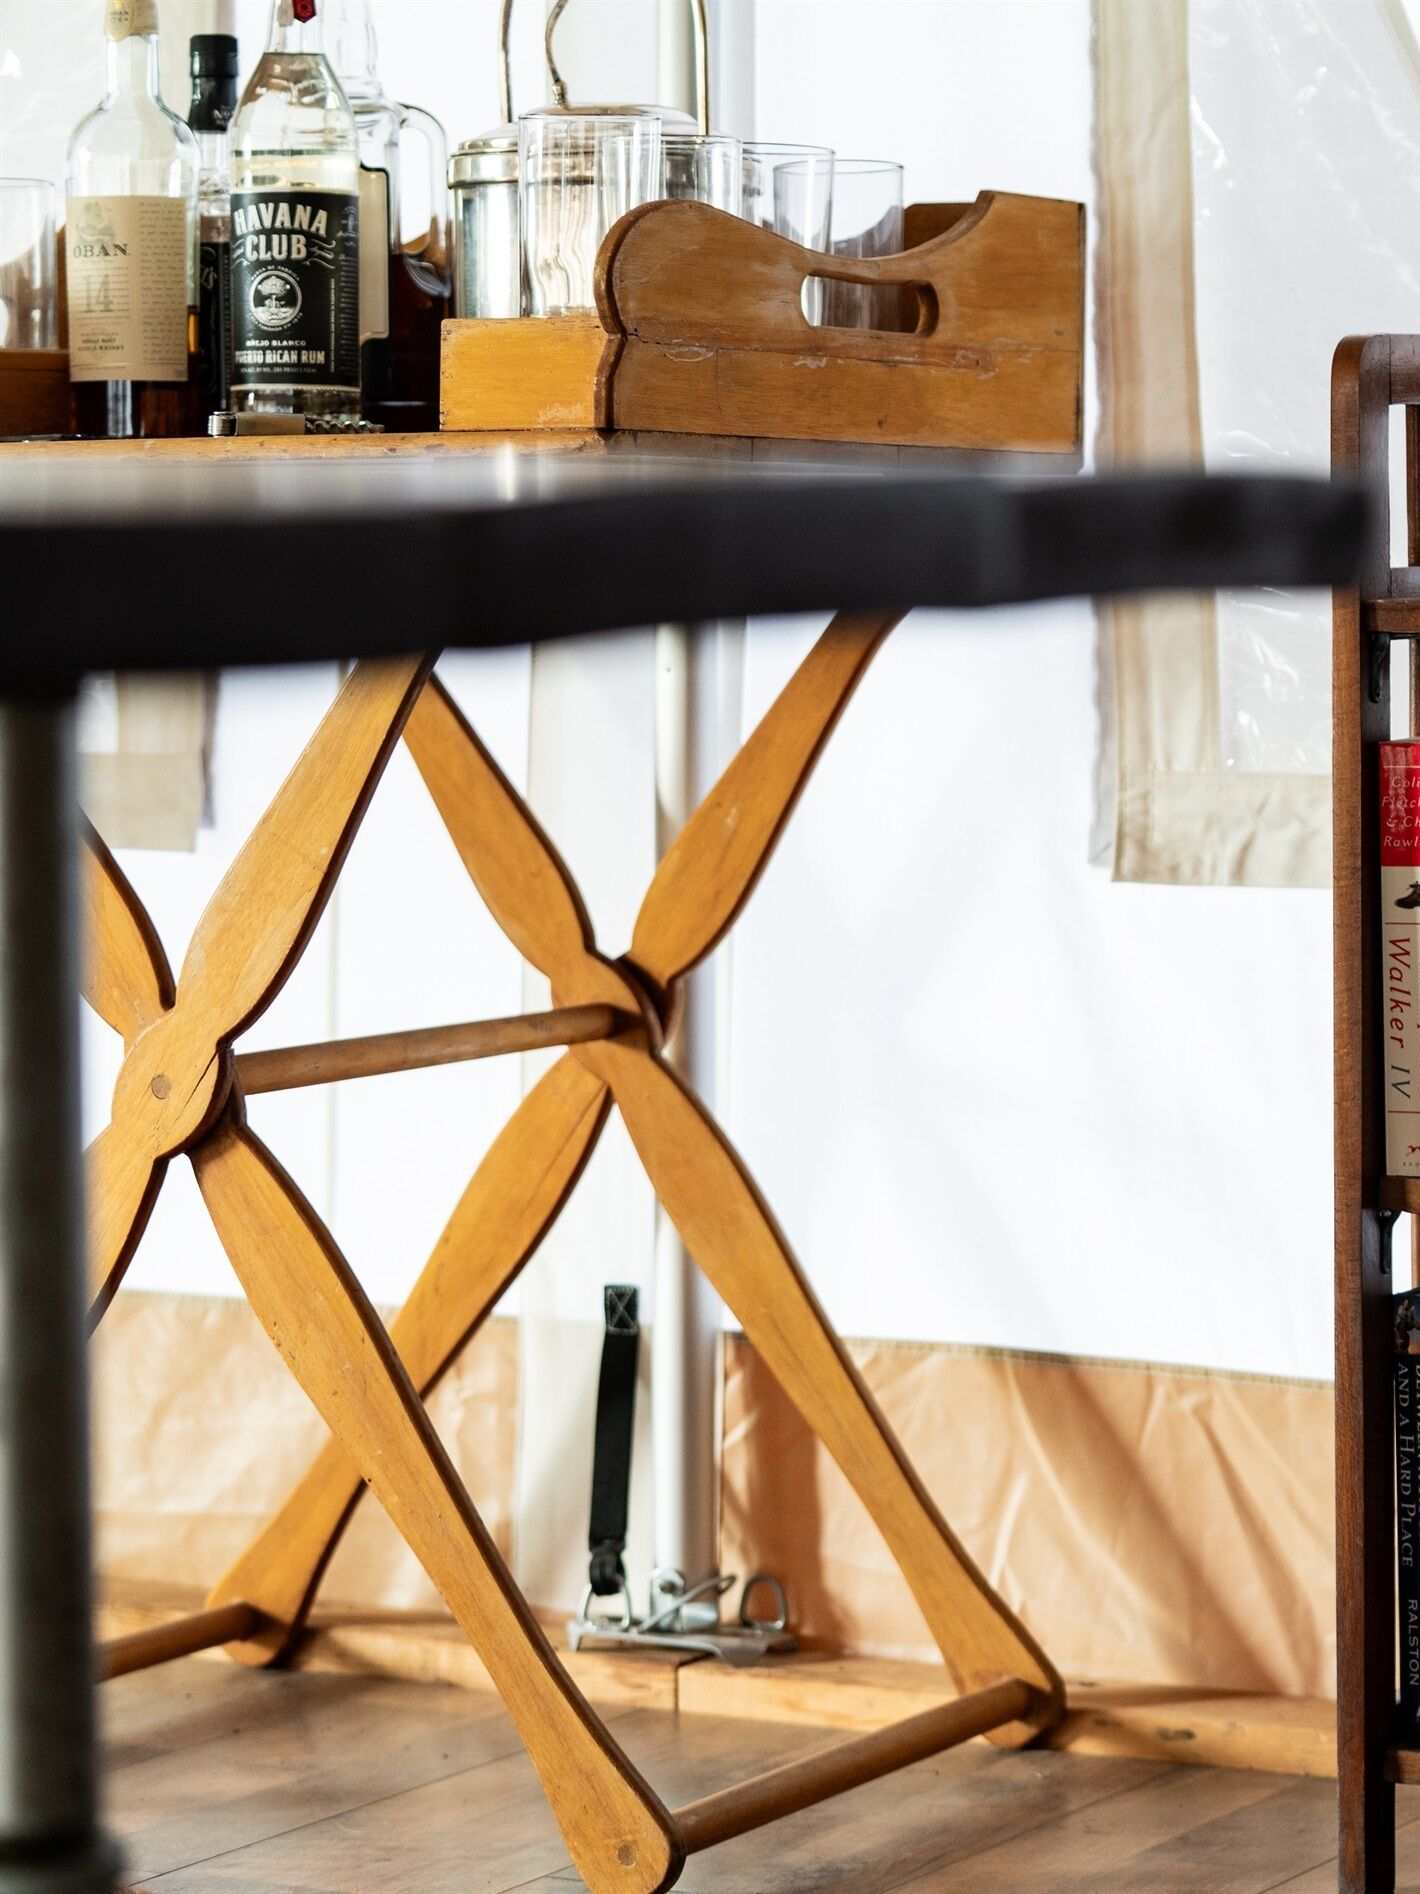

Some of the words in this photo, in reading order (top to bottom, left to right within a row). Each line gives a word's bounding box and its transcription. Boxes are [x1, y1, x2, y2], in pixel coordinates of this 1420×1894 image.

[233, 202, 328, 237] HAVANA
[245, 233, 308, 262] CLUB
[265, 350, 298, 364] RICAN
[303, 350, 326, 364] RUM
[1388, 936, 1411, 1049] Walker
[1391, 1064, 1411, 1099] IV
[1408, 1599, 1419, 1686] RALSTON
